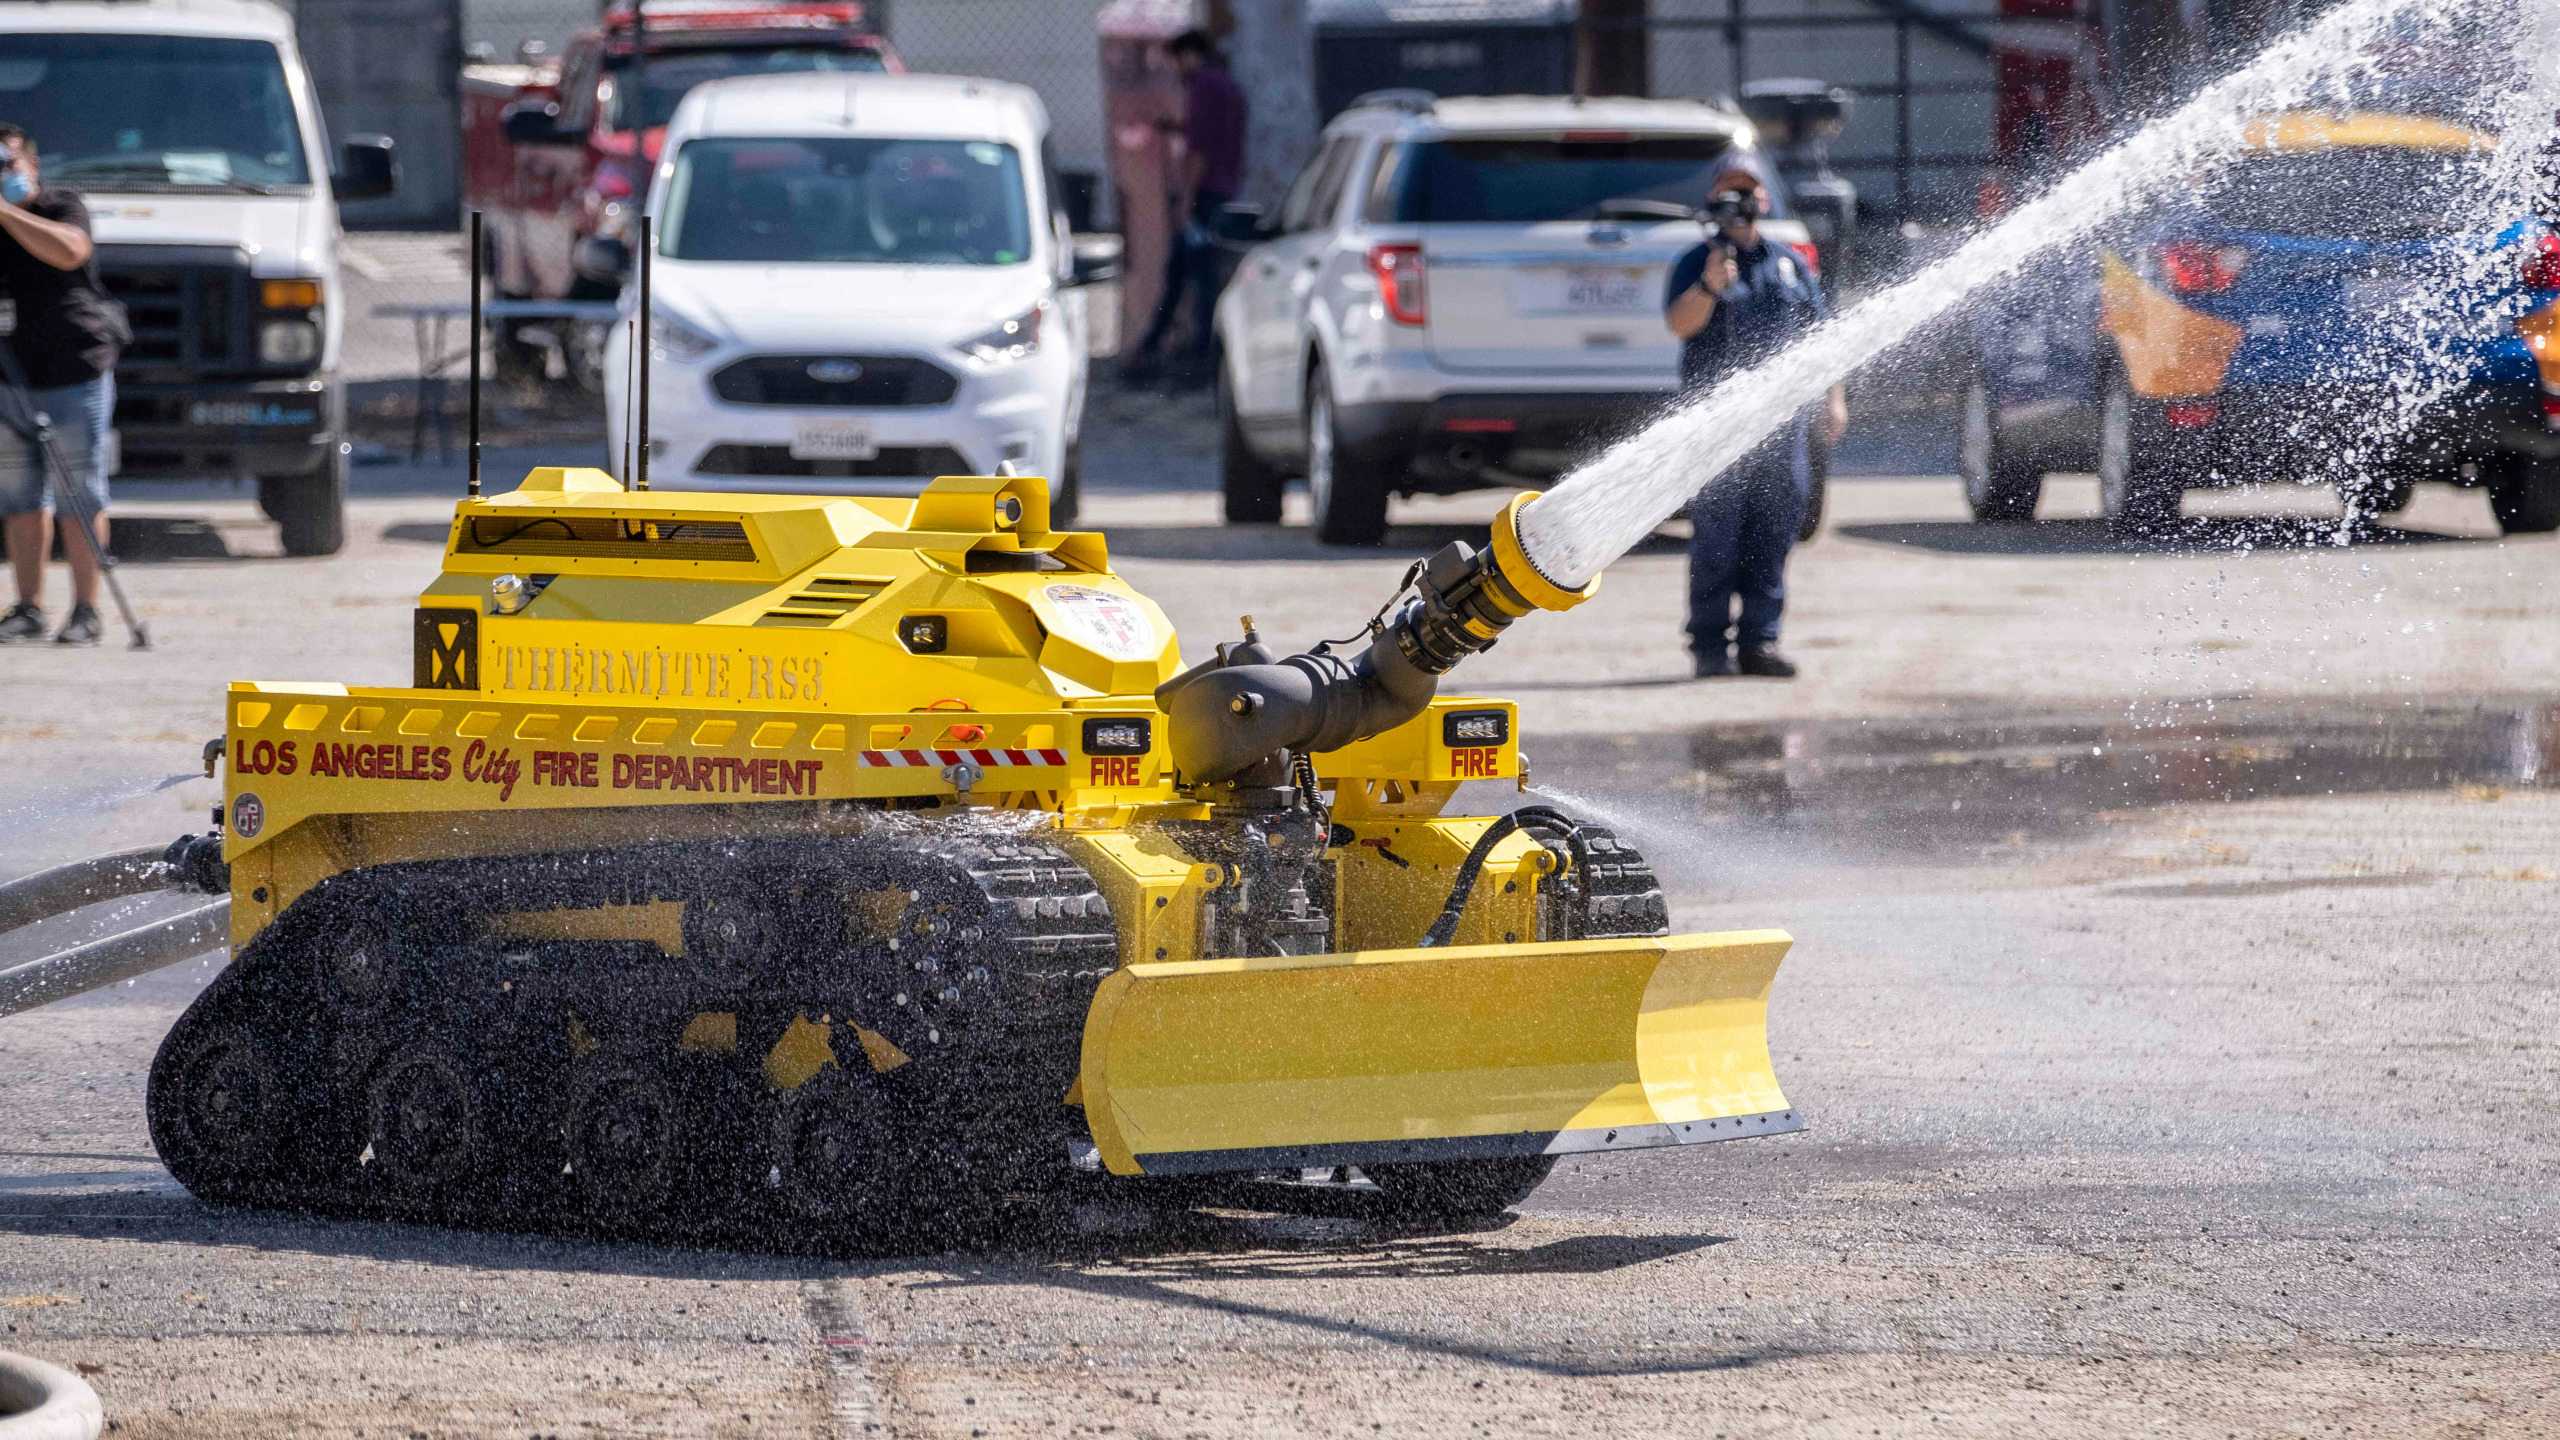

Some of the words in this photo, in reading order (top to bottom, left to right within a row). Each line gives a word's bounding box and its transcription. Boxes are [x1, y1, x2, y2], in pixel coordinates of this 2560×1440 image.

[496, 646, 730, 698] THERMITE
[748, 654, 823, 700] RS3
[236, 739, 298, 775] LOS
[310, 742, 452, 781] ANGELES
[463, 738, 521, 802] City
[534, 750, 599, 787] FIRE
[612, 753, 823, 795] DEPARTMENT
[1091, 757, 1140, 786] FIRE
[1451, 747, 1498, 777] FIRE
